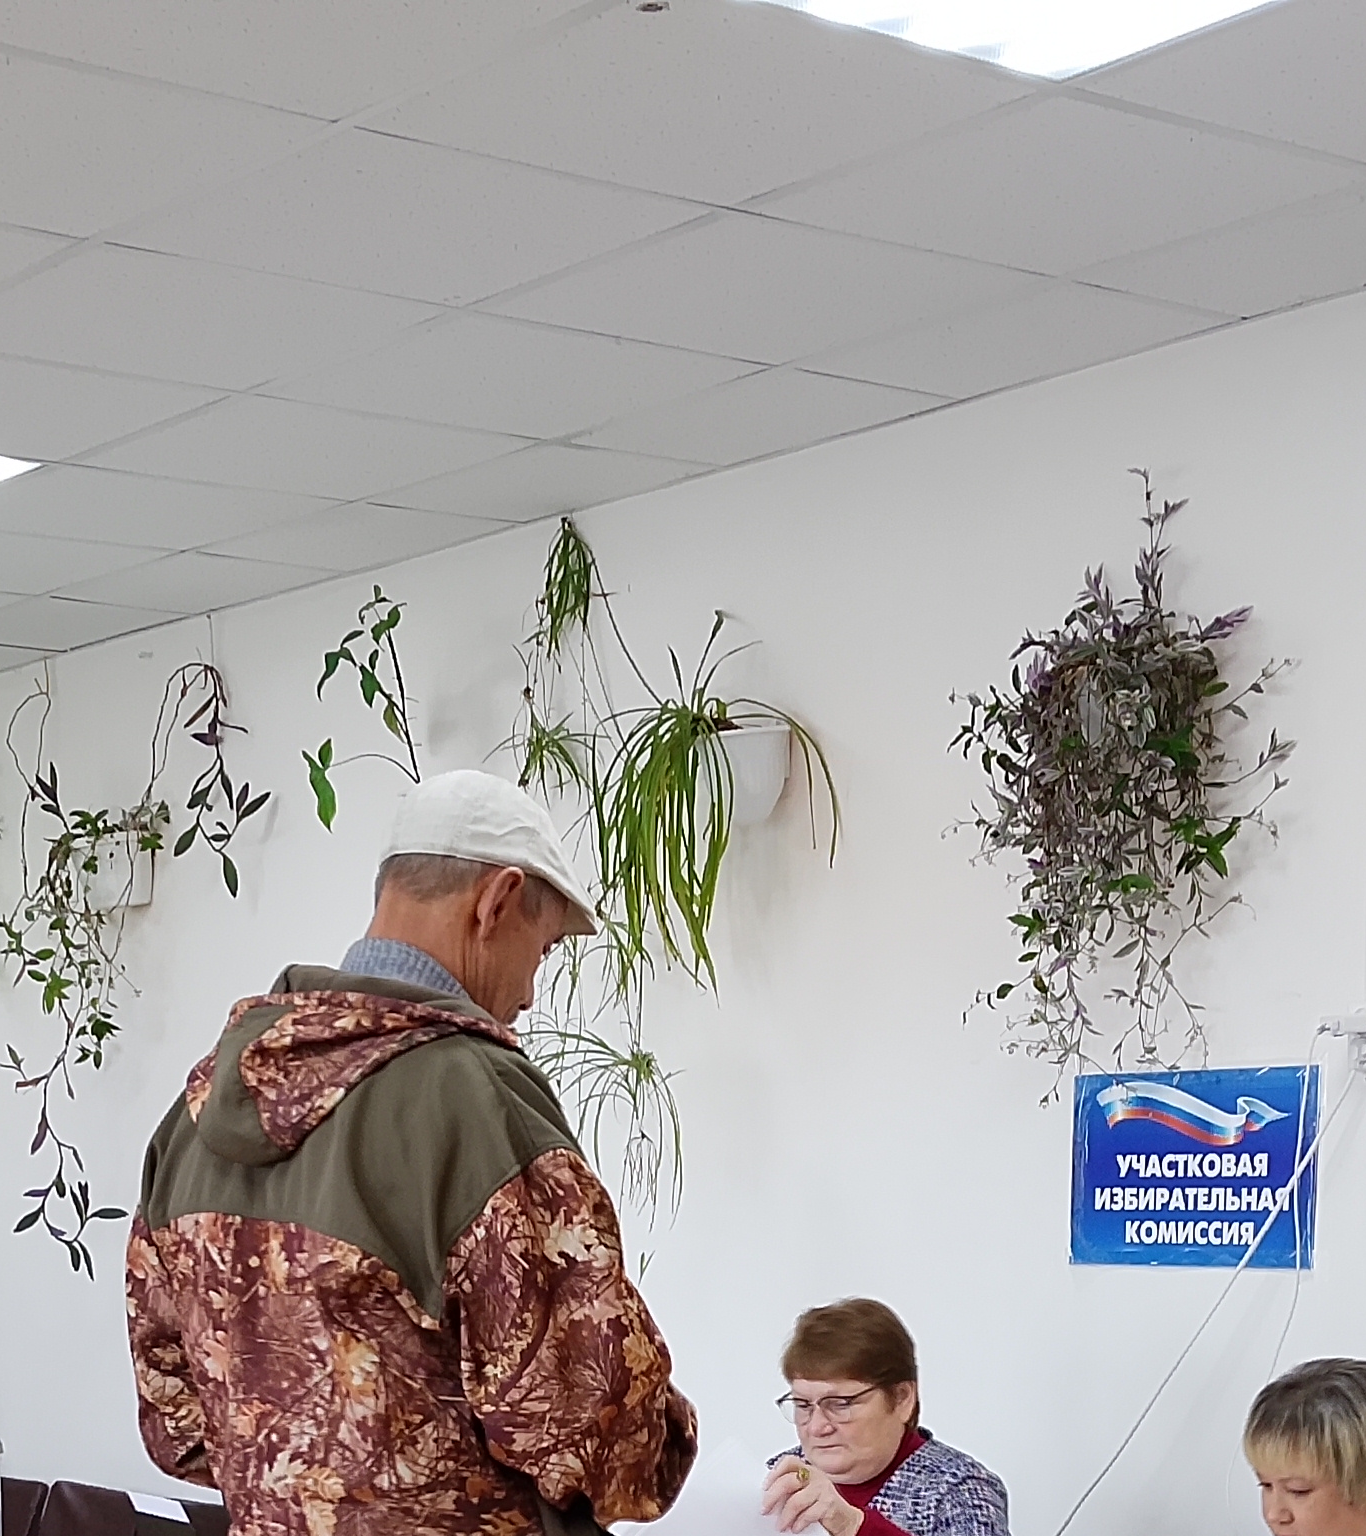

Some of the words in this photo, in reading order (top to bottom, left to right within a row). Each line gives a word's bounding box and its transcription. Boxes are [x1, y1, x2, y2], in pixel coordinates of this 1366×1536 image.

[1116, 1152, 1269, 1178] УЧАСТКОВАЯ
[1094, 1186, 1291, 1212] ИЗБИРАТЕЛЬНАЯ
[1124, 1220, 1255, 1245] КОМИССИЯ
